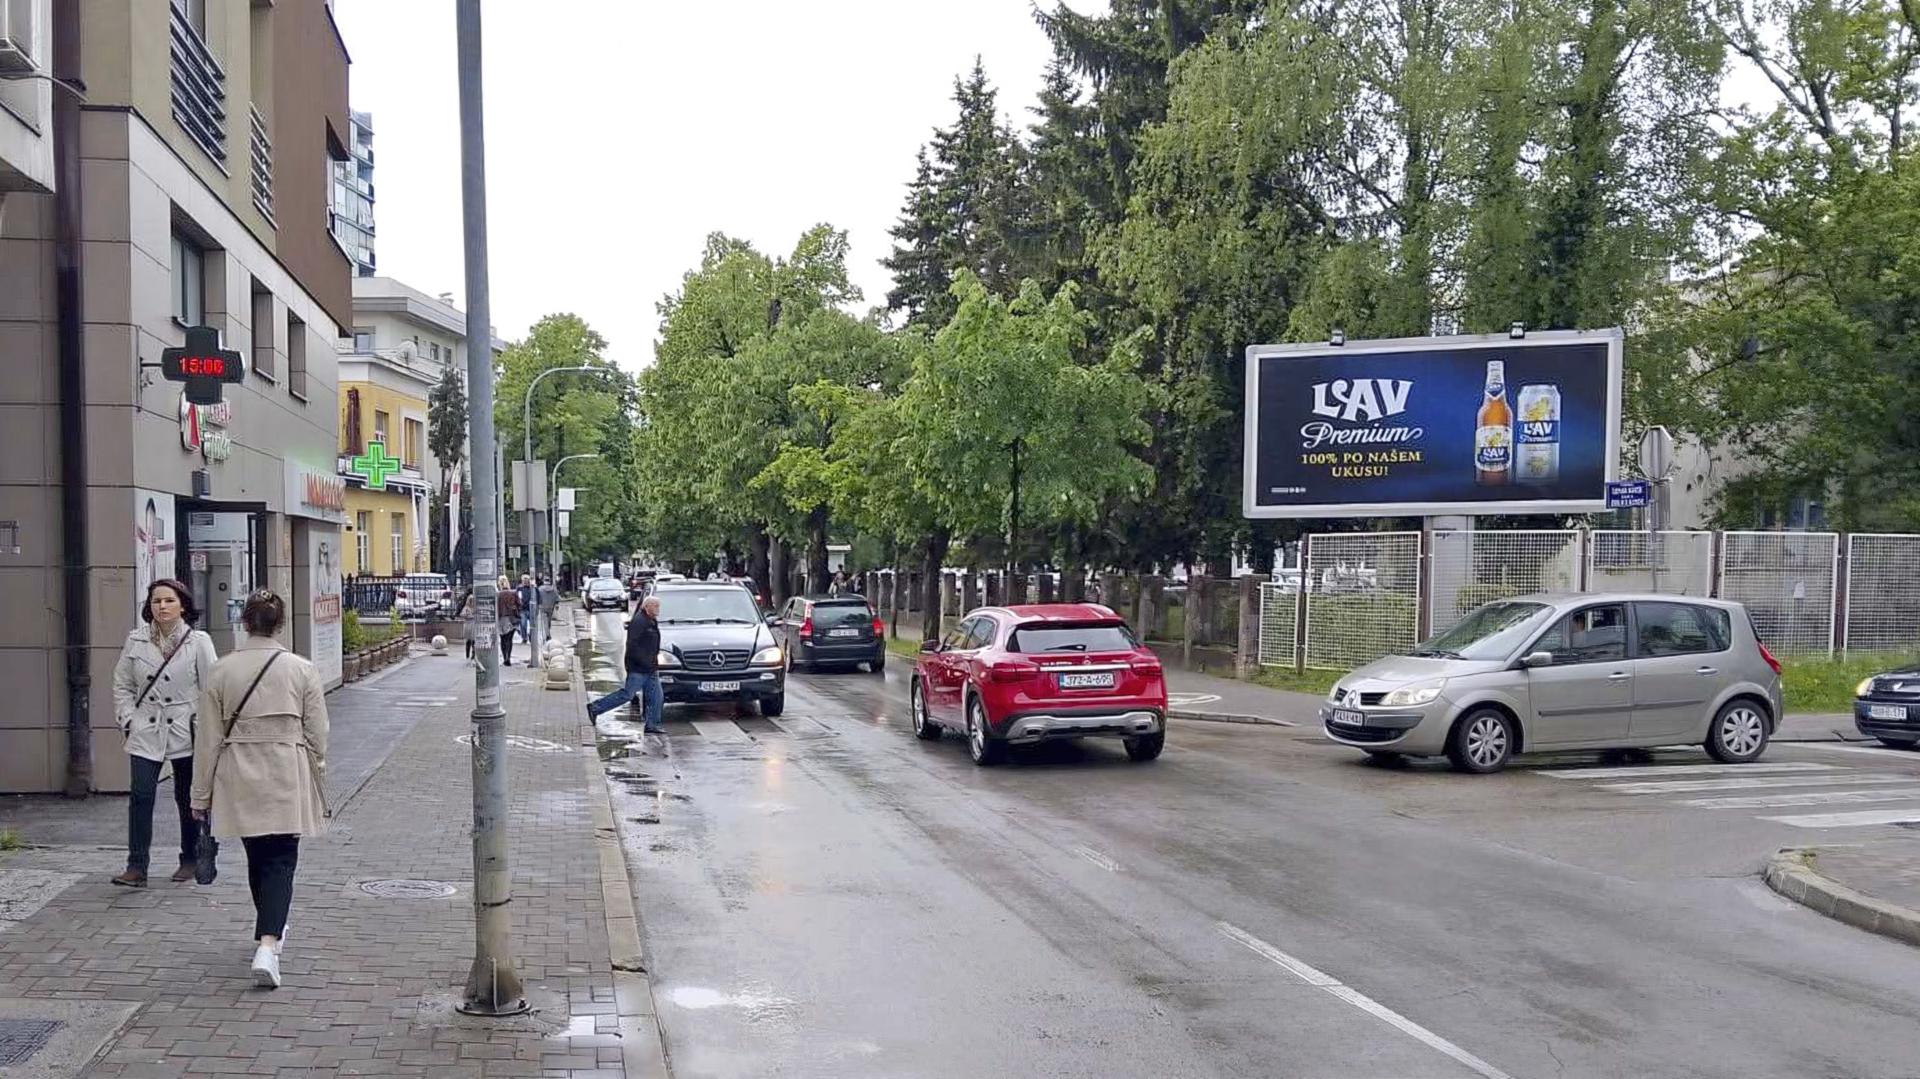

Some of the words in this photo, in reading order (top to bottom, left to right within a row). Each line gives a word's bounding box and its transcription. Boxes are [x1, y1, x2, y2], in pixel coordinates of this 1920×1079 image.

[1300, 421, 1423, 449] Premium
[1302, 453, 1337, 464] 100%
[1343, 453, 1363, 463] PO
[1368, 450, 1421, 463] NAŠEM
[1332, 466, 1388, 477] UKUSU!
